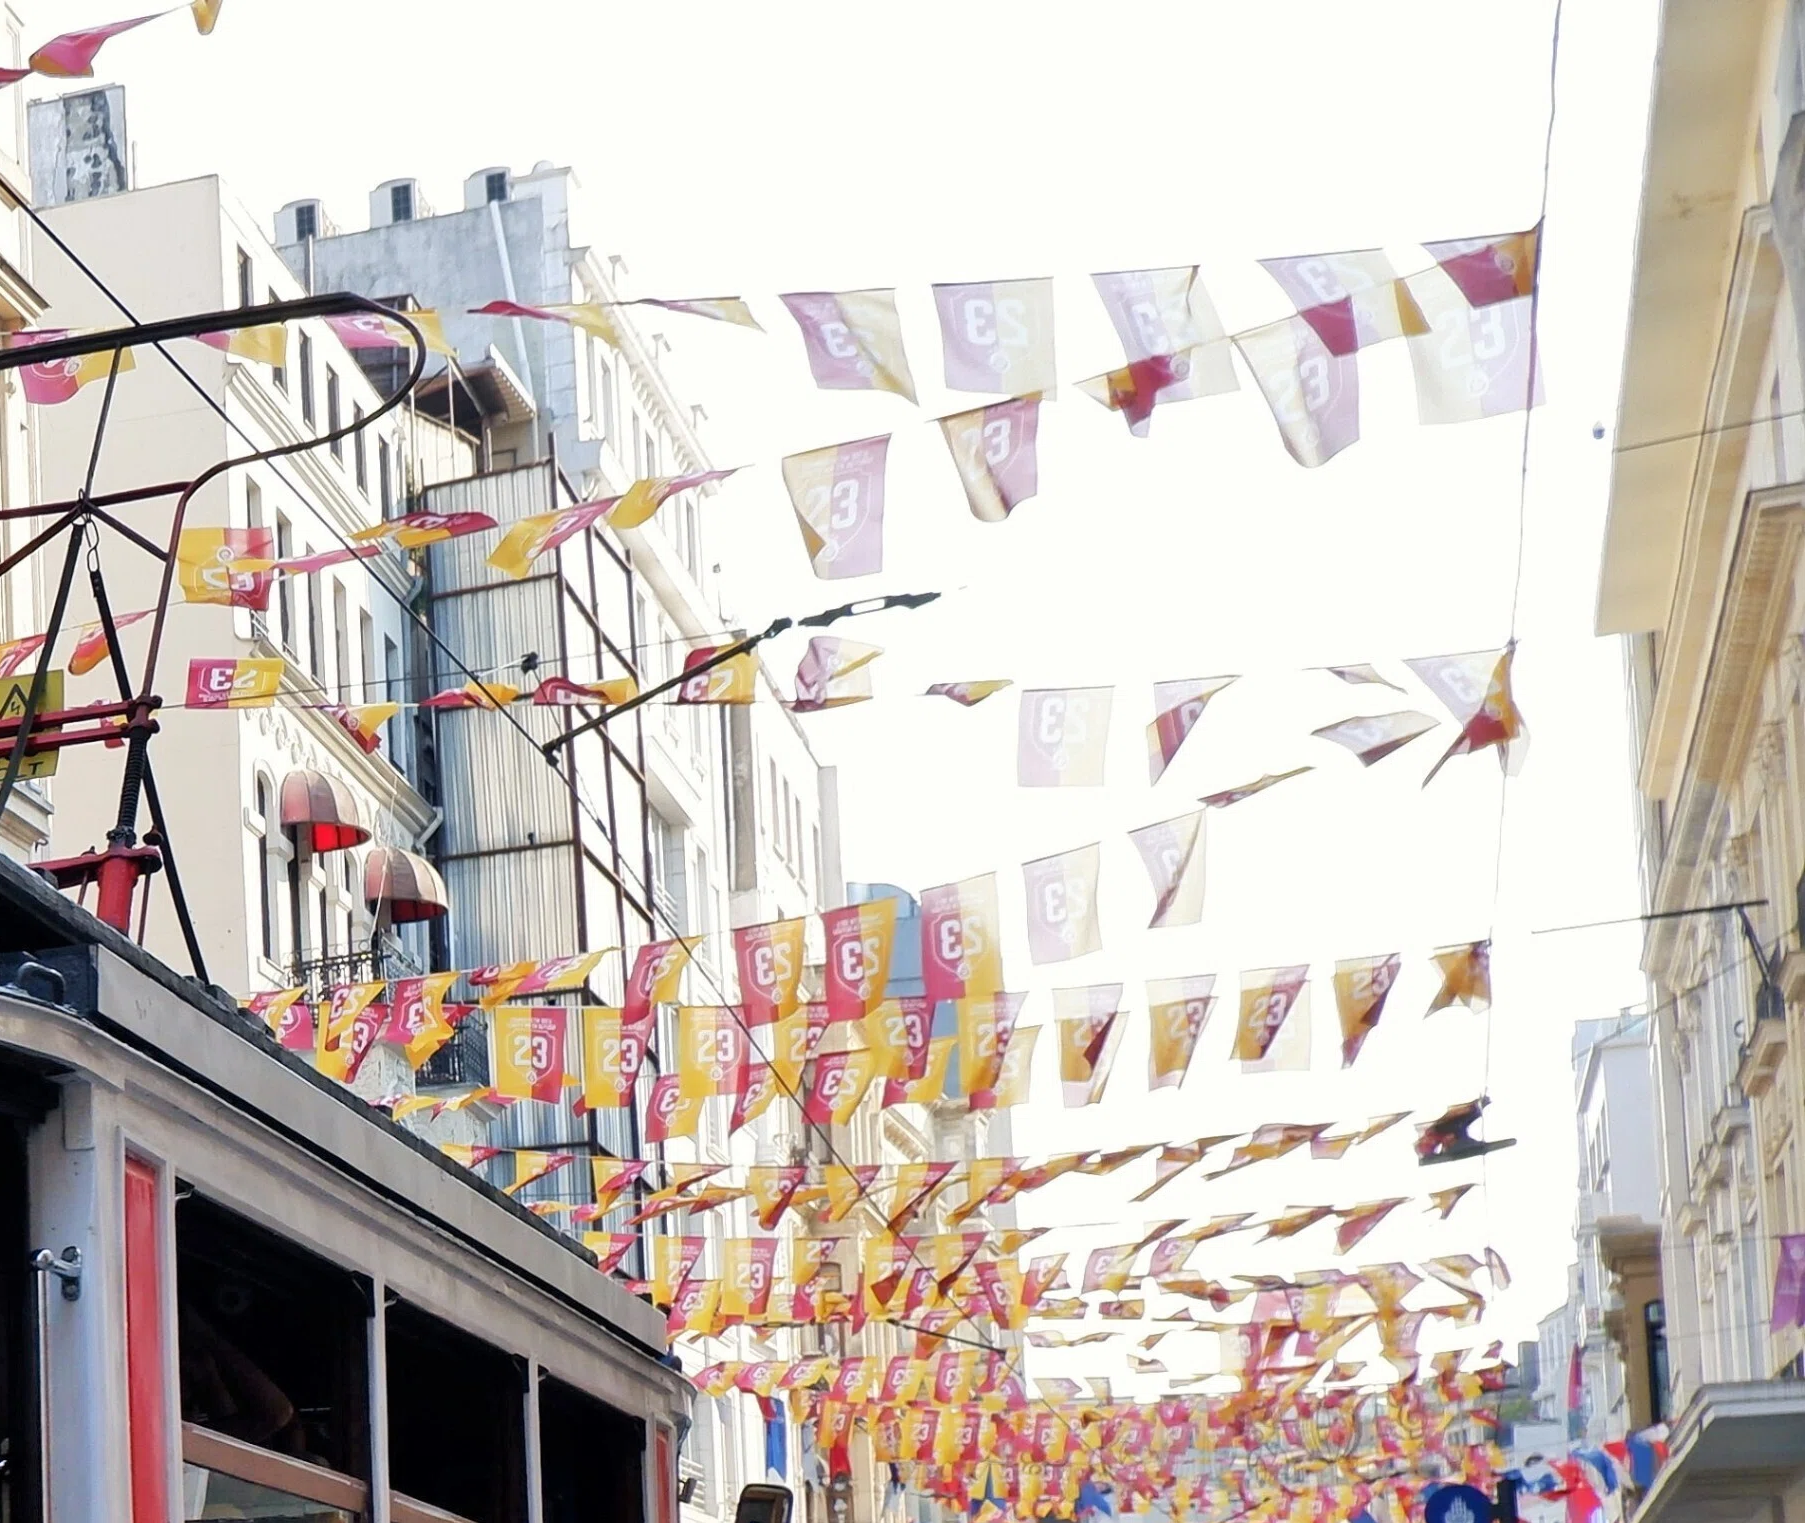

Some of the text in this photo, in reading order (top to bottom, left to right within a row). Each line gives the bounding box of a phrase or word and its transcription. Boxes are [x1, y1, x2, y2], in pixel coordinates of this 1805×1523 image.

[697, 1028, 735, 1062] 23
[885, 1014, 924, 1048] 23
[513, 1035, 548, 1069] 23
[602, 1037, 639, 1074] 23
[735, 1260, 766, 1289] 23
